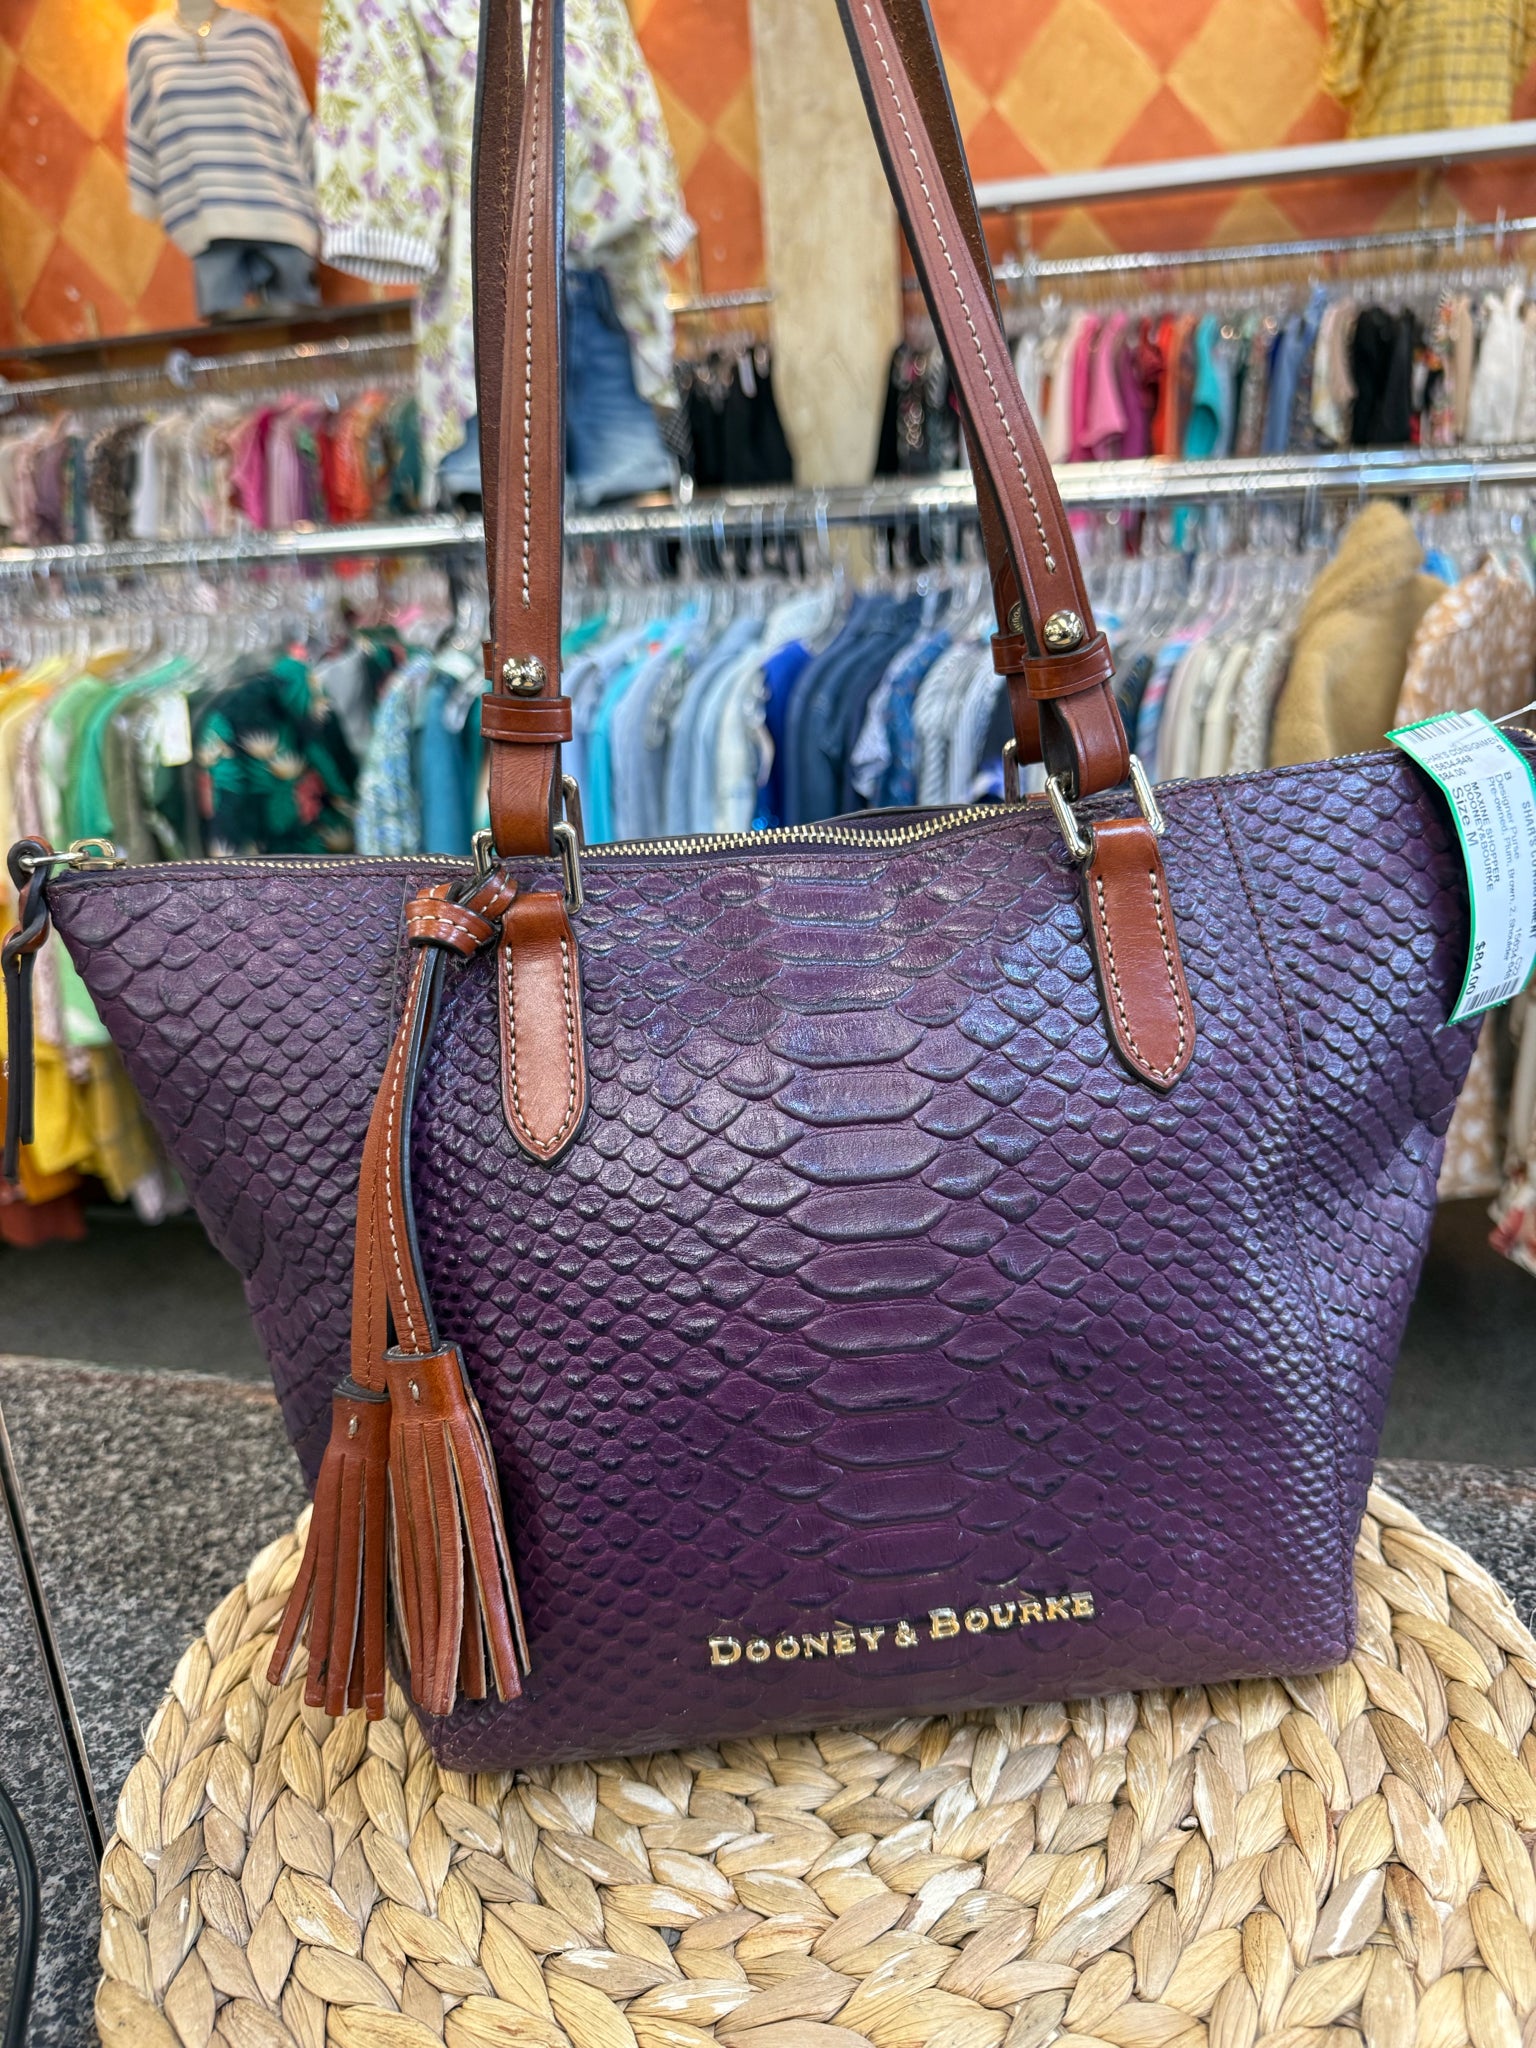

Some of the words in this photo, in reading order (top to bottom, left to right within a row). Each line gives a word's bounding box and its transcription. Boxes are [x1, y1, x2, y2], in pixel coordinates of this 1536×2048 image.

[1504, 771, 1512, 780] B
[1452, 786, 1471, 826] Size
[1466, 831, 1479, 847] M
[1463, 783, 1494, 893] DOONEY&BOURKE
[1471, 781, 1491, 826] MAXINE
[1485, 827, 1500, 884] SHOPPER
[1495, 773, 1514, 823] Designer
[1509, 826, 1520, 860] Purse
[1465, 941, 1487, 996] $84.00
[707, 1626, 886, 1668] DOONEY
[893, 1620, 919, 1650] &
[927, 1590, 1096, 1641] BOURKE
